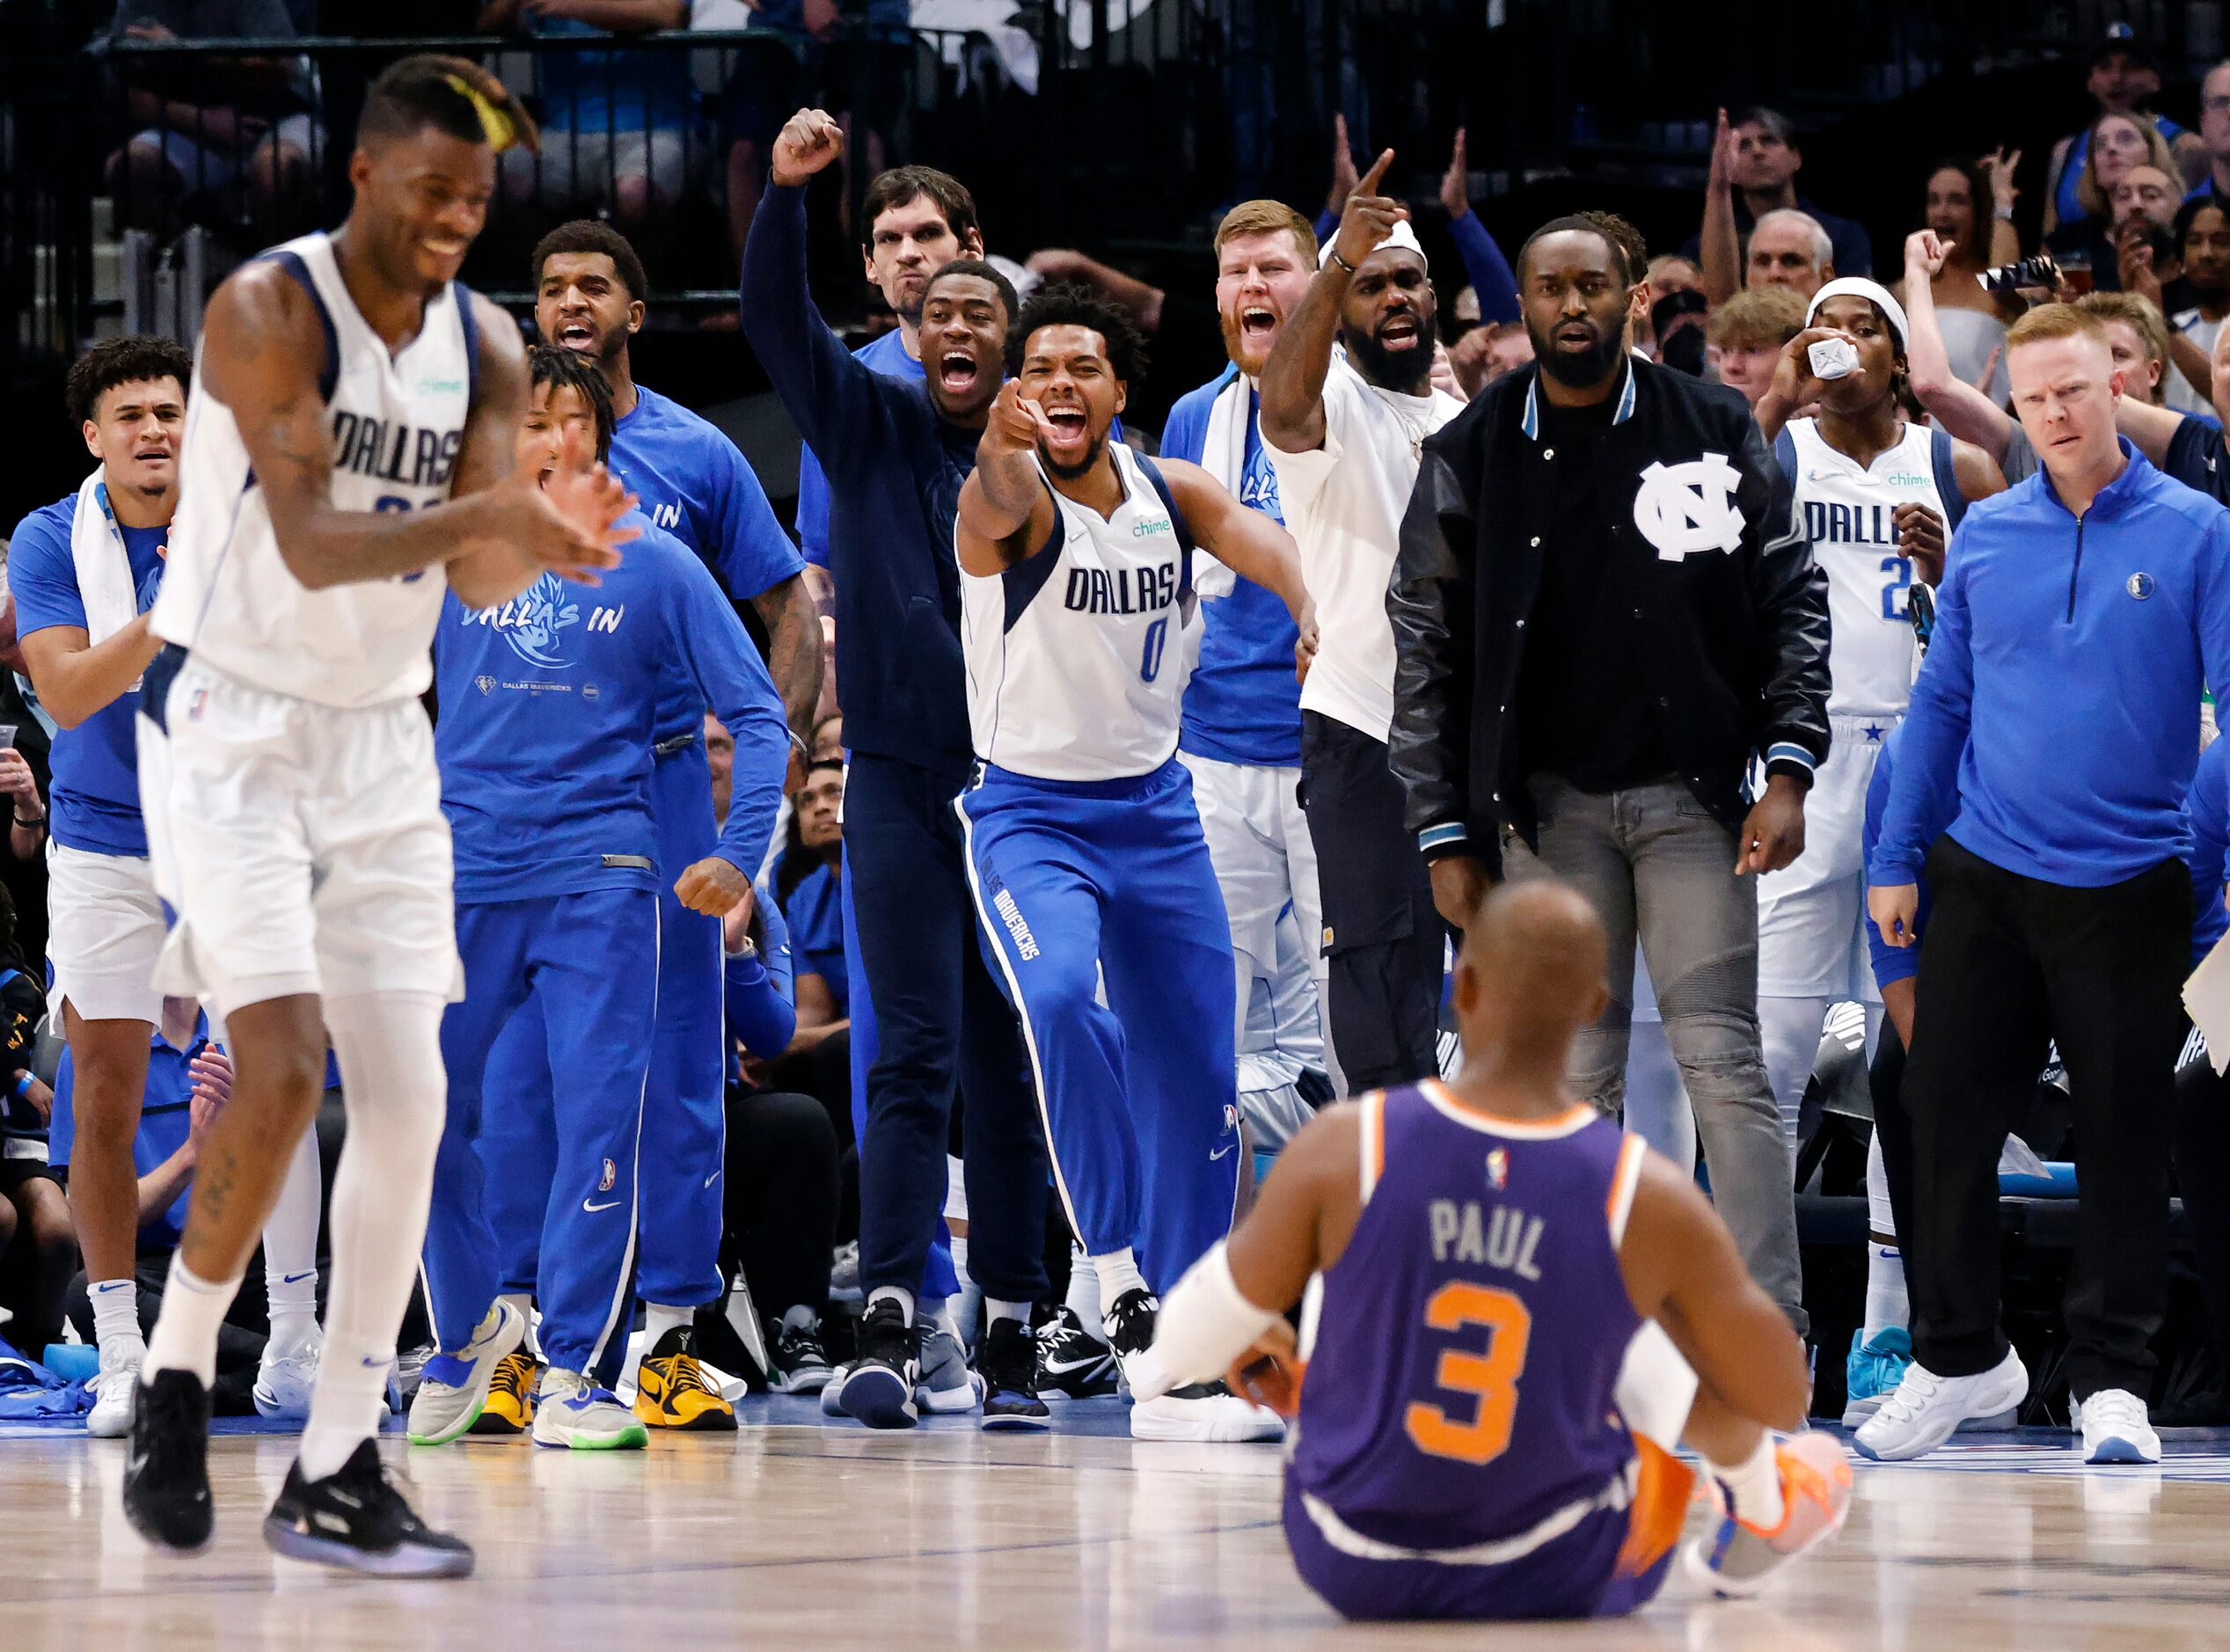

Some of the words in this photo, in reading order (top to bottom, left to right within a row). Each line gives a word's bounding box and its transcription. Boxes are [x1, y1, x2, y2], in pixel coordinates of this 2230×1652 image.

[333, 409, 463, 486] DALLAS
[1889, 472, 1932, 487] chime
[653, 497, 682, 529] IN
[1132, 520, 1172, 538] chime
[1064, 562, 1174, 615] DALLAS
[588, 603, 625, 634] IN
[1140, 617, 1168, 683] 0
[993, 888, 1041, 962] MAVERICKS
[1429, 1198, 1546, 1281] PAUL
[1403, 1280, 1532, 1466] 3
